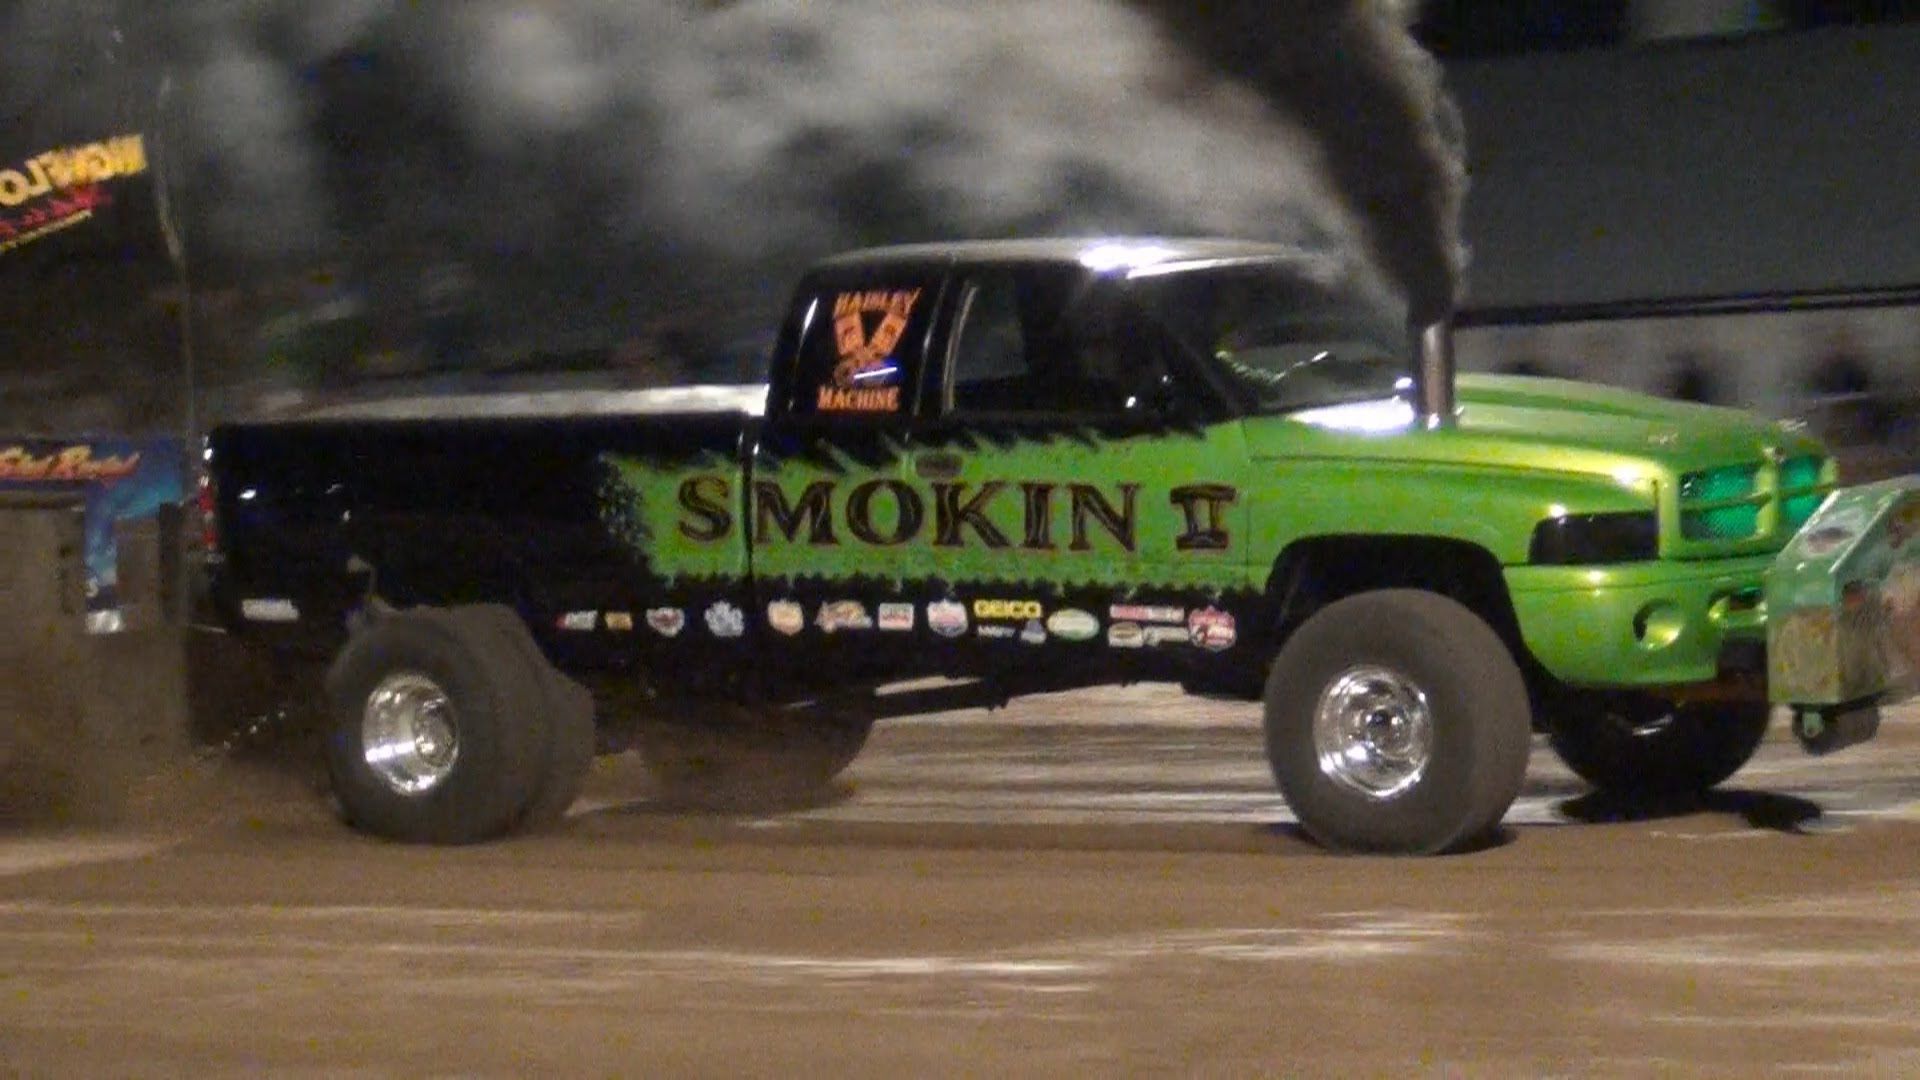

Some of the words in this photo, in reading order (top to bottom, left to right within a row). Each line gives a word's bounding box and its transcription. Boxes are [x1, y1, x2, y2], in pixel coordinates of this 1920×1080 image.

[818, 386, 899, 411] MACHINE
[677, 475, 1142, 552] SMOKIN
[1168, 483, 1237, 551] II
[974, 599, 1042, 619] GEICO
